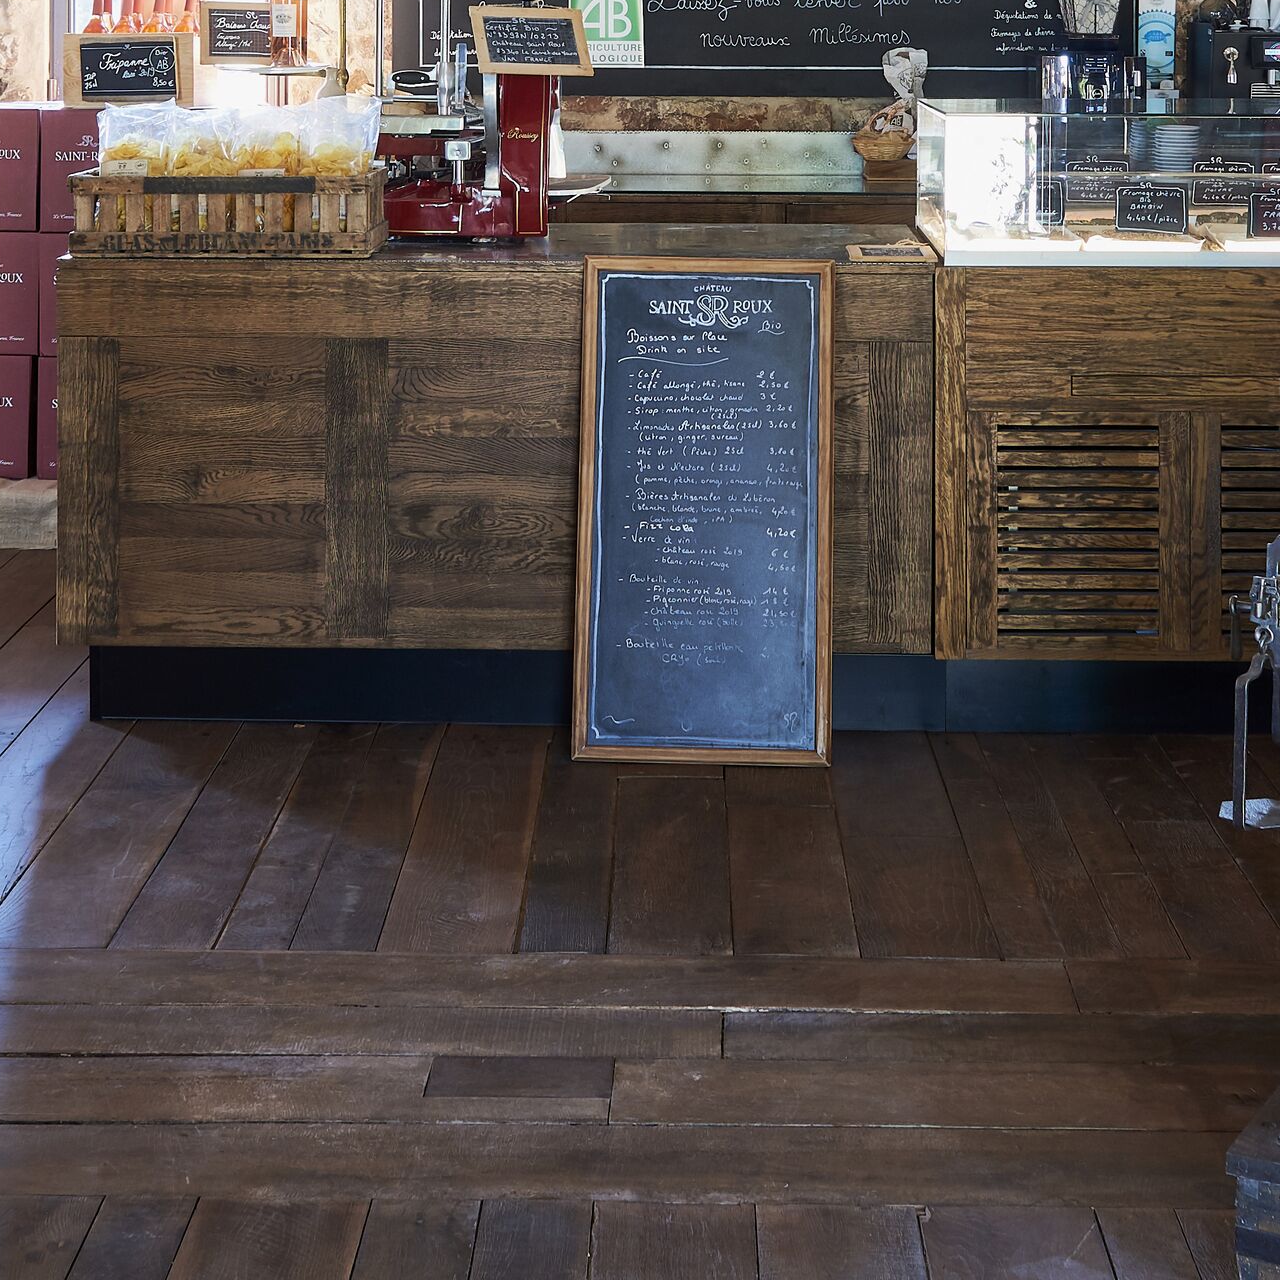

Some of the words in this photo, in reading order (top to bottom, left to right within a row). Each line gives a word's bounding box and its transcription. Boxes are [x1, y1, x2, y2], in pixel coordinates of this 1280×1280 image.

[700, 30, 791, 48] nouveaux
[694, 284, 732, 293] CHÂTEAU
[649, 300, 694, 315] SAINT
[733, 300, 773, 313] ROUX
[627, 328, 676, 343] Boissons
[636, 345, 668, 355] Drink
[697, 345, 720, 353] site
